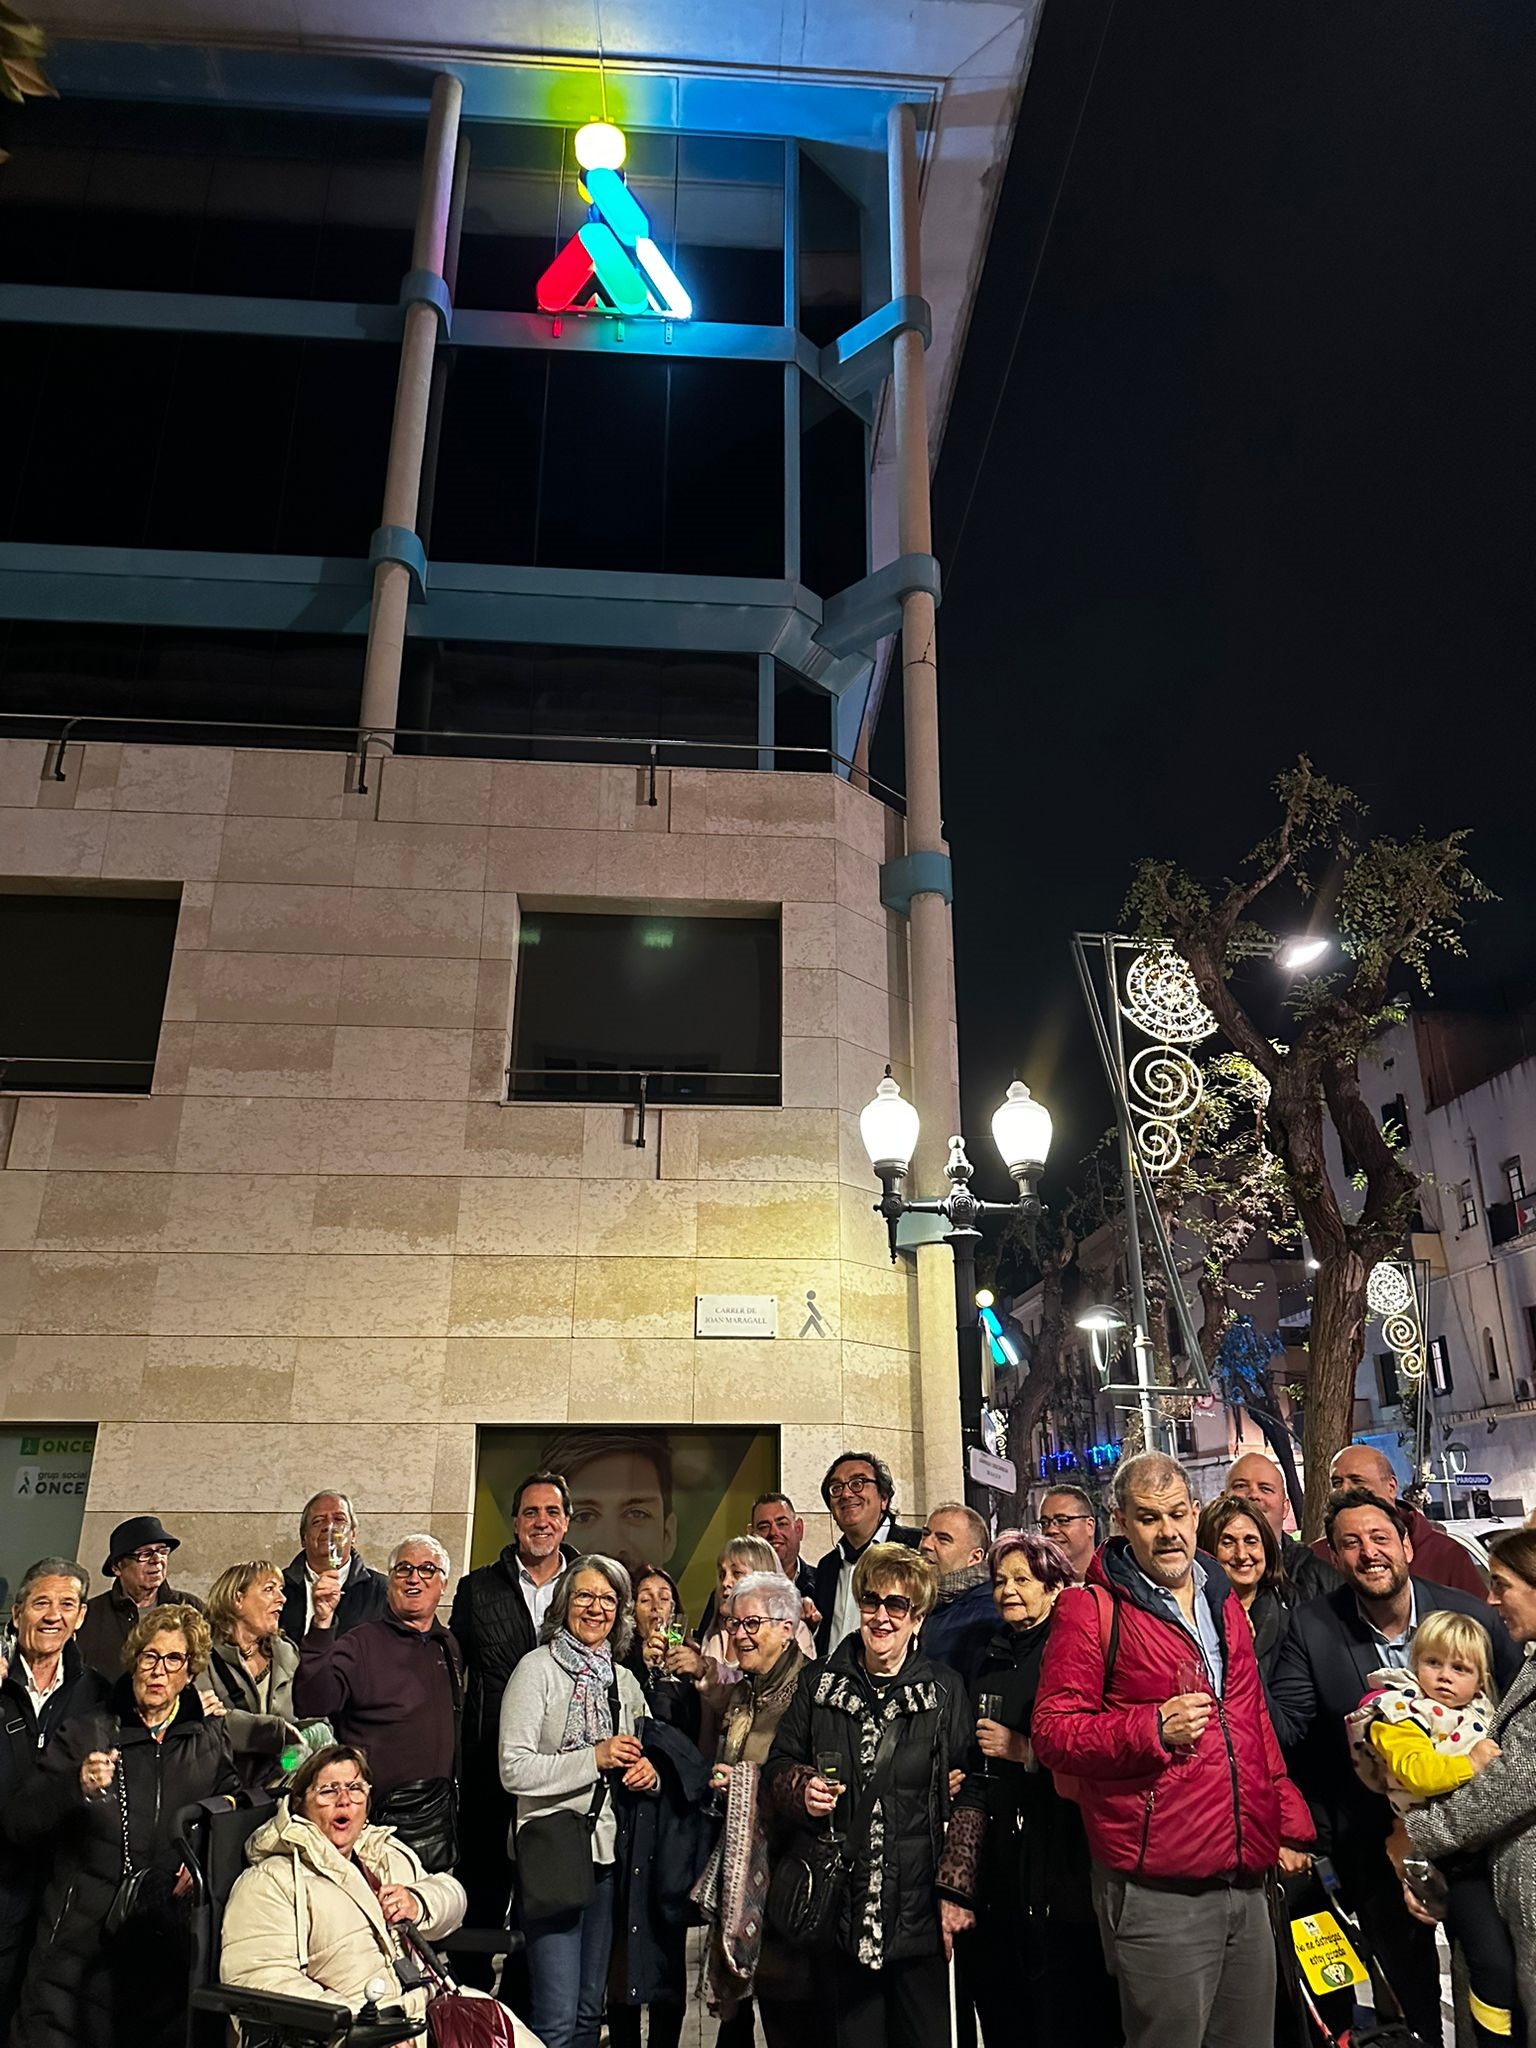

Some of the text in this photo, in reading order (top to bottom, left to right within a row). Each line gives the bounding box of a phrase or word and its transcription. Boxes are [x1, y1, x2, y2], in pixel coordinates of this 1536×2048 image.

[704, 1316, 768, 1325] JOAN MARAGALL
[42, 1440, 94, 1453] ONCE
[38, 1471, 88, 1480] grup social
[35, 1482, 85, 1495] ONCE
